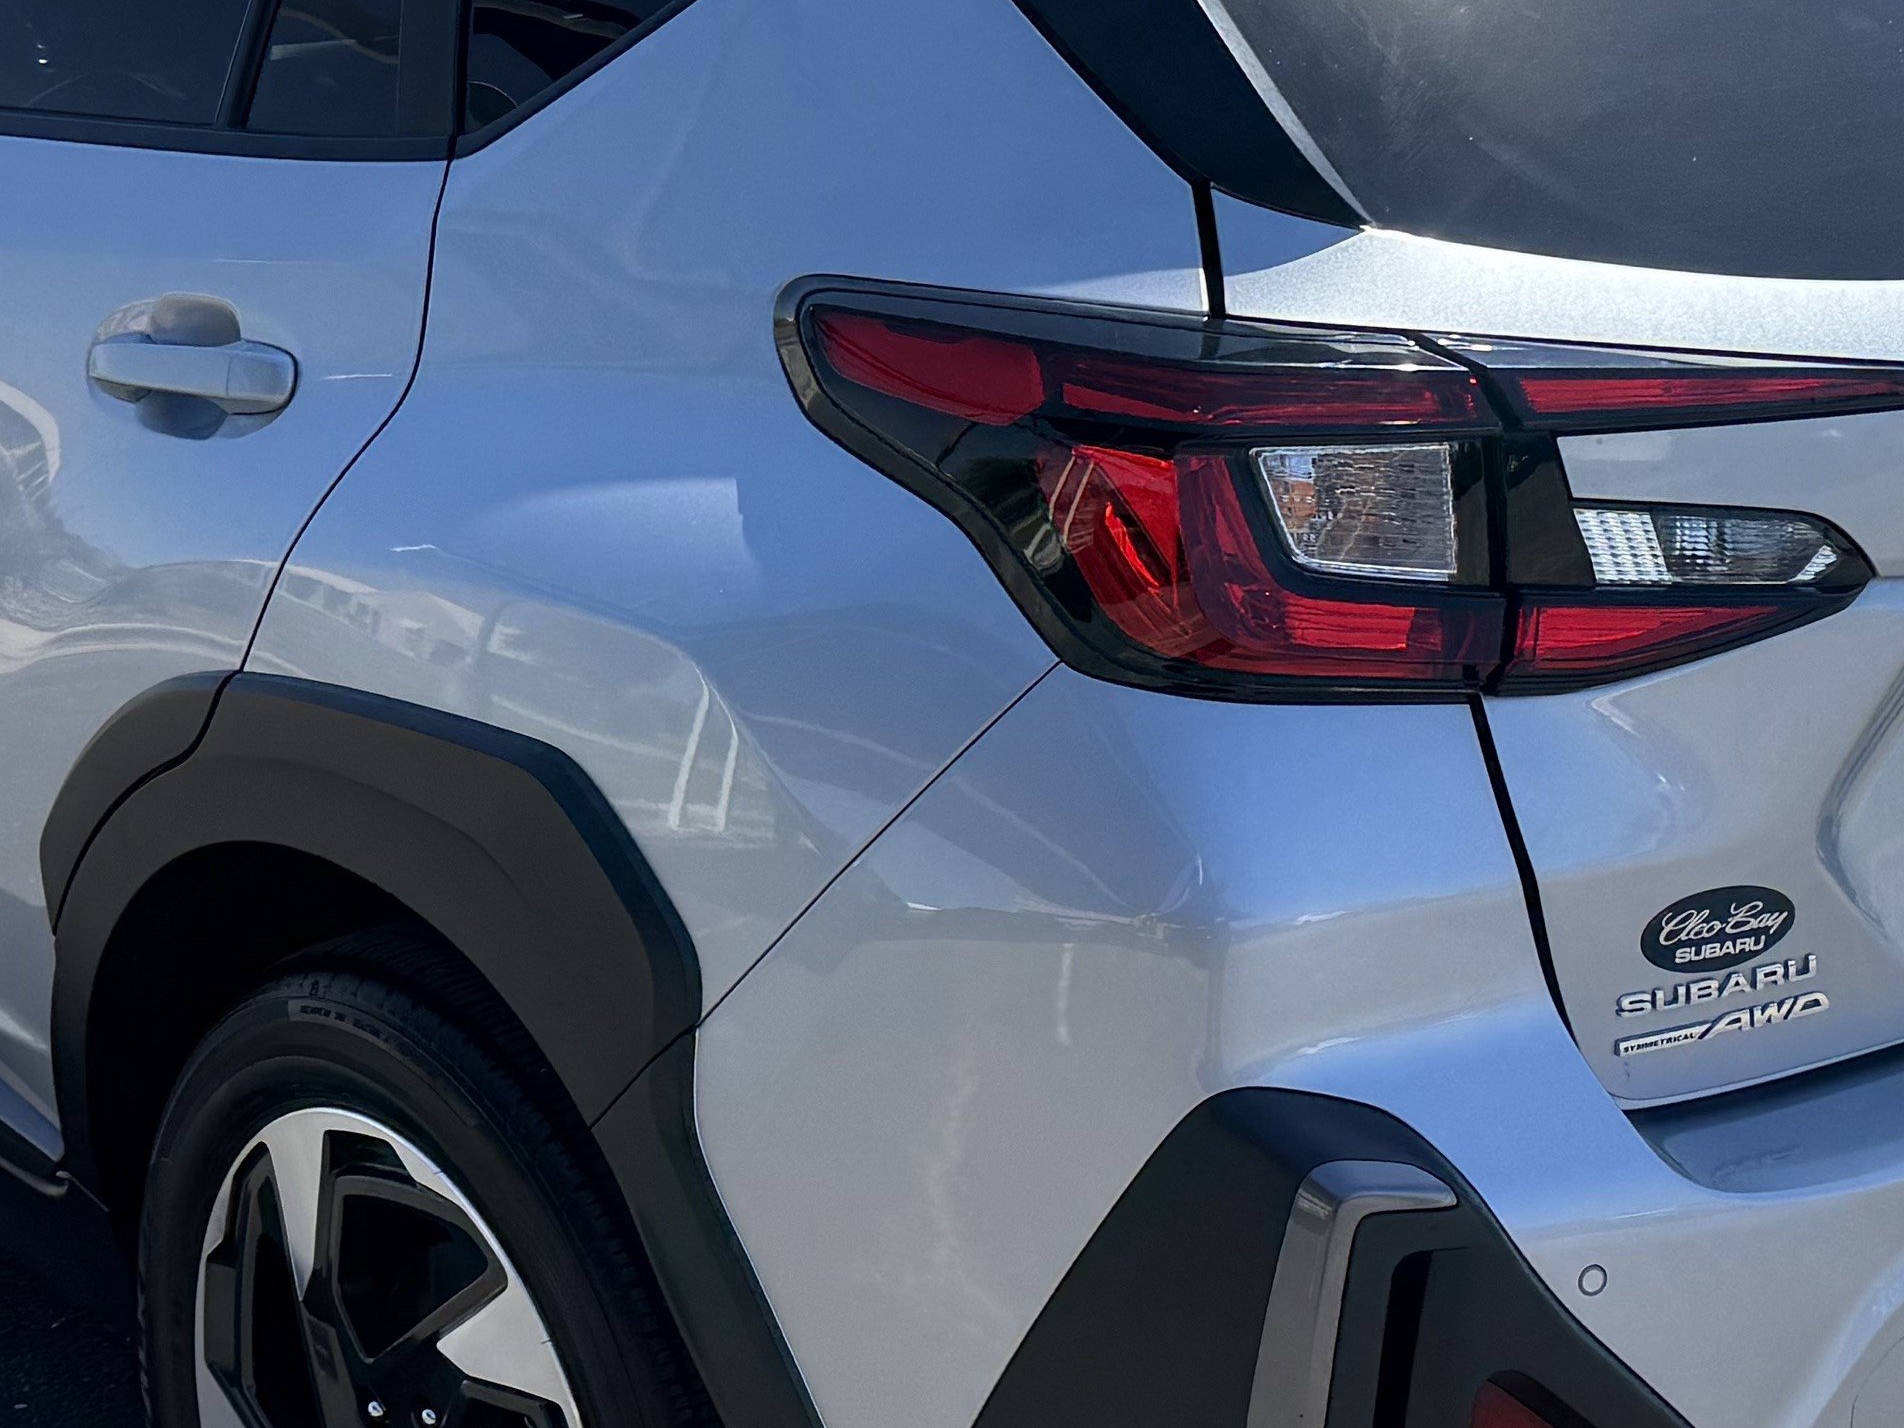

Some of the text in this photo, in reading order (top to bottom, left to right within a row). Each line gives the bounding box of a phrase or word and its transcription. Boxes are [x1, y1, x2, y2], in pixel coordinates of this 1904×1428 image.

[1726, 900, 1789, 934] Bay
[1674, 935, 1766, 964] SUBARU
[1616, 953, 1818, 1019] SUBARU
[1698, 991, 1831, 1040] AWD
